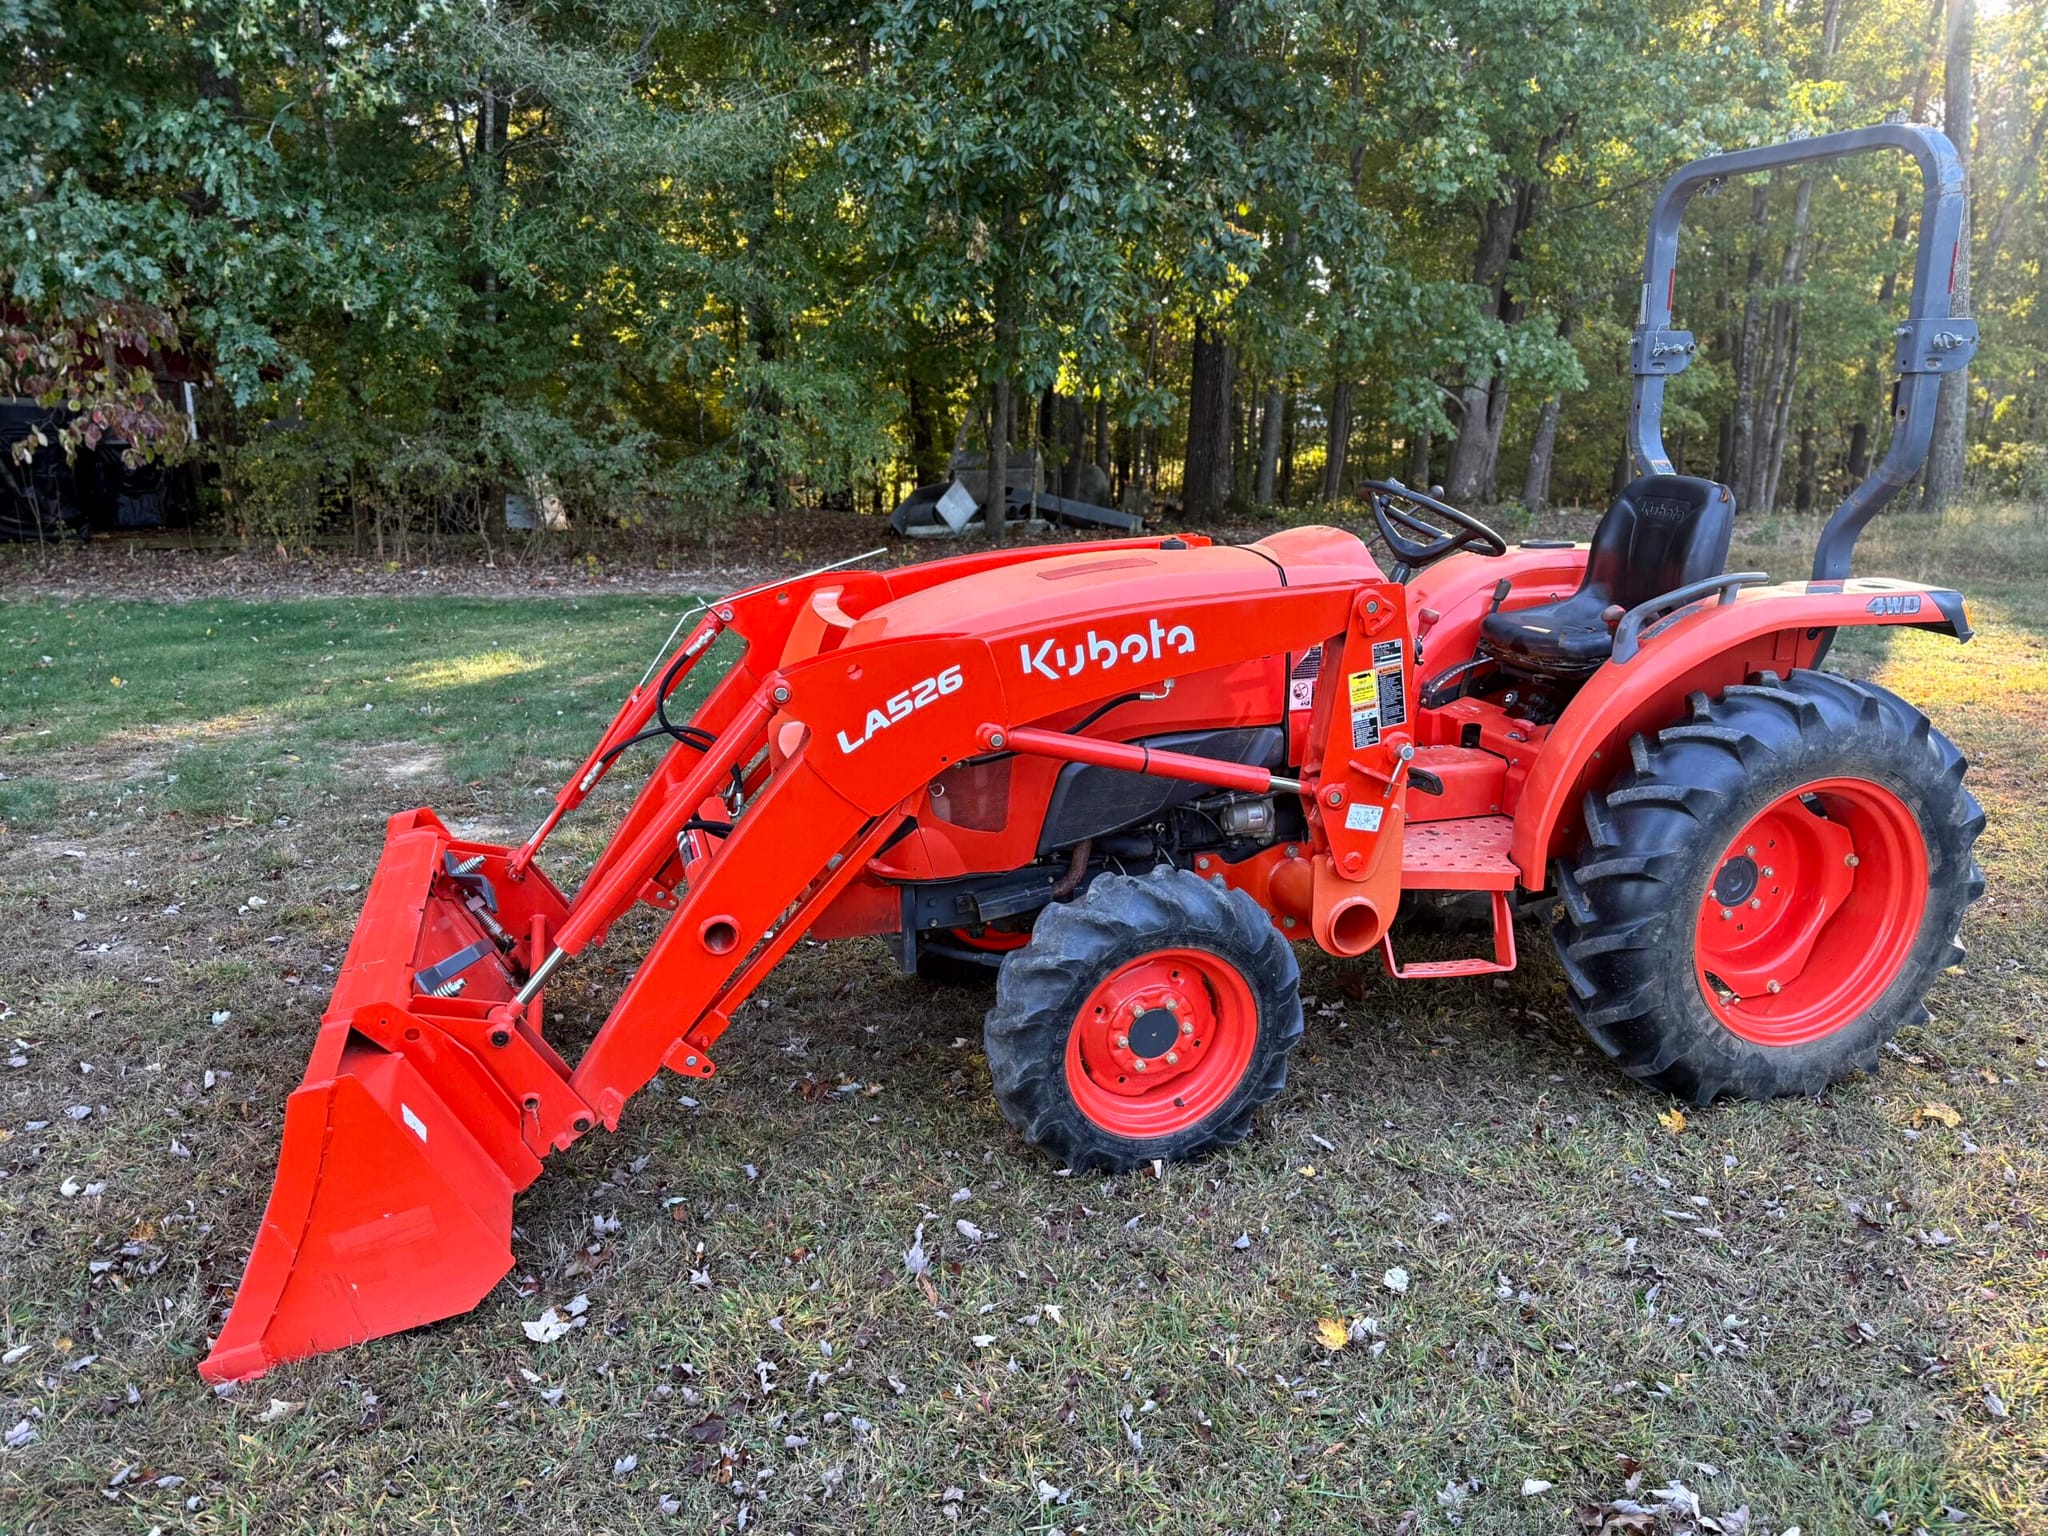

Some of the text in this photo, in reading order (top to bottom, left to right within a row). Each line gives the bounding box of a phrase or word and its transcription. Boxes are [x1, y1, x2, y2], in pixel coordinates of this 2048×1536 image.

[1640, 500, 1685, 523] Kubota
[1866, 594, 1922, 615] 4WD
[1020, 618, 1195, 680] Kubota
[836, 664, 963, 755] LA526
